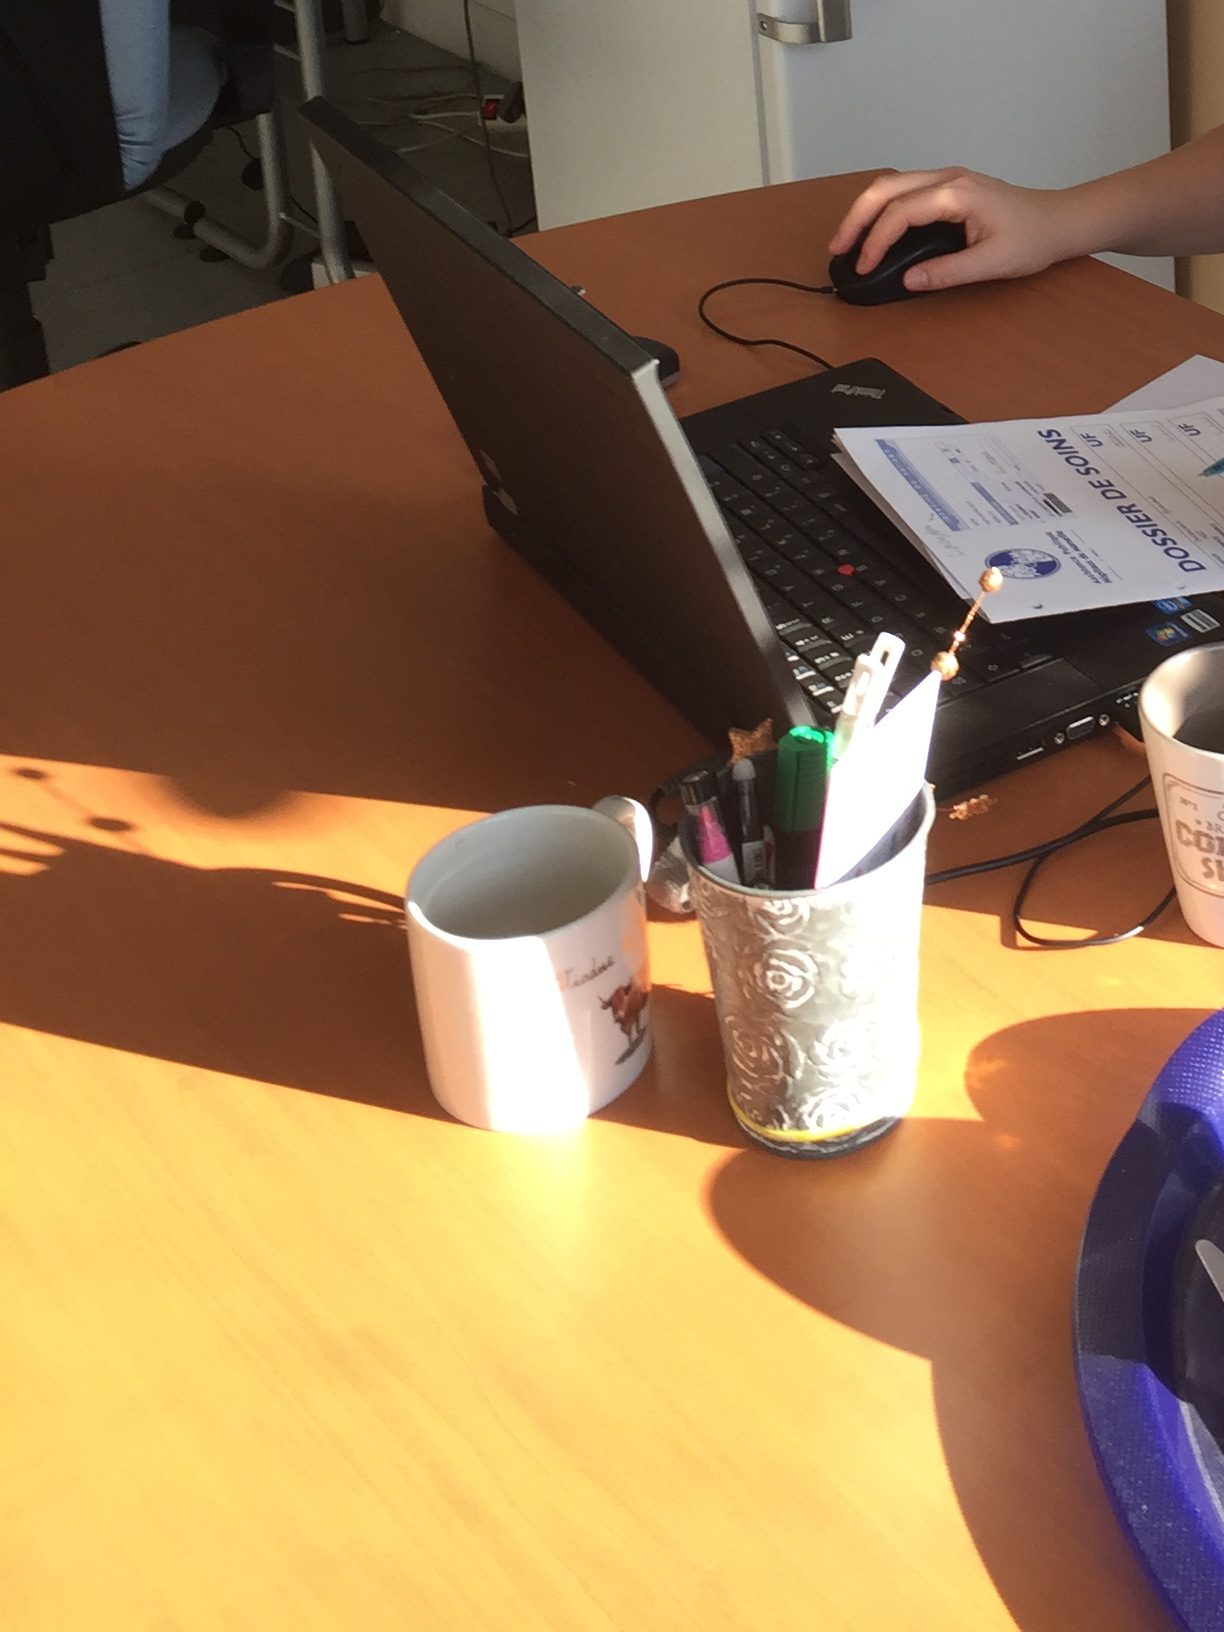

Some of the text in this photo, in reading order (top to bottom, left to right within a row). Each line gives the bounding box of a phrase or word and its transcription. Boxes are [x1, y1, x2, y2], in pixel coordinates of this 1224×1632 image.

[1129, 427, 1154, 443] UF
[1177, 421, 1202, 436] UF
[1079, 431, 1105, 447] UF
[1033, 429, 1101, 475] SOINS
[1085, 479, 1128, 500] DE
[1110, 503, 1207, 572] DOSSIER
